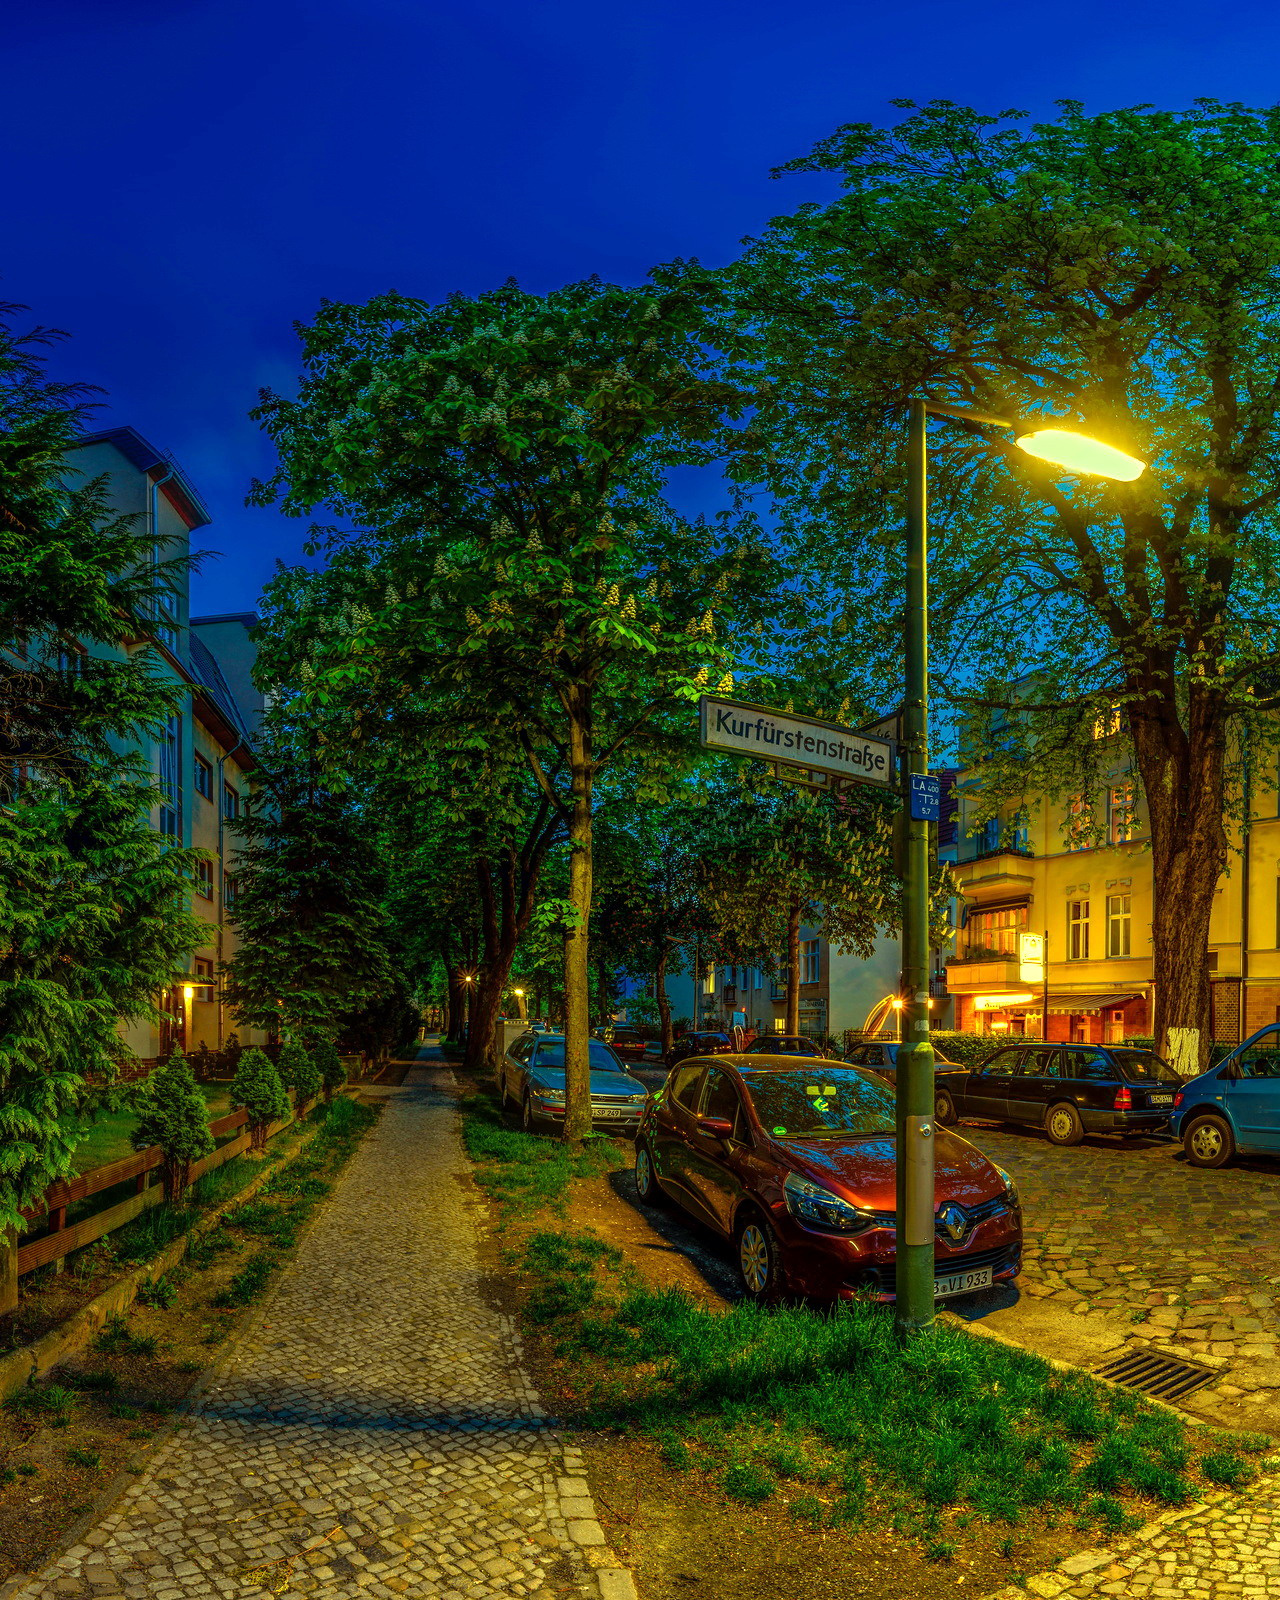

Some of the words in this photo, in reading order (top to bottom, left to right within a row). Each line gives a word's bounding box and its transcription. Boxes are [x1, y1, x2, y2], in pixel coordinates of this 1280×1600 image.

[716, 708, 885, 772] Kurfürstenstraße
[913, 780, 926, 791] LA
[921, 807, 931, 815] 5.7
[949, 1276, 964, 1291] VI
[966, 1271, 988, 1288] 933
